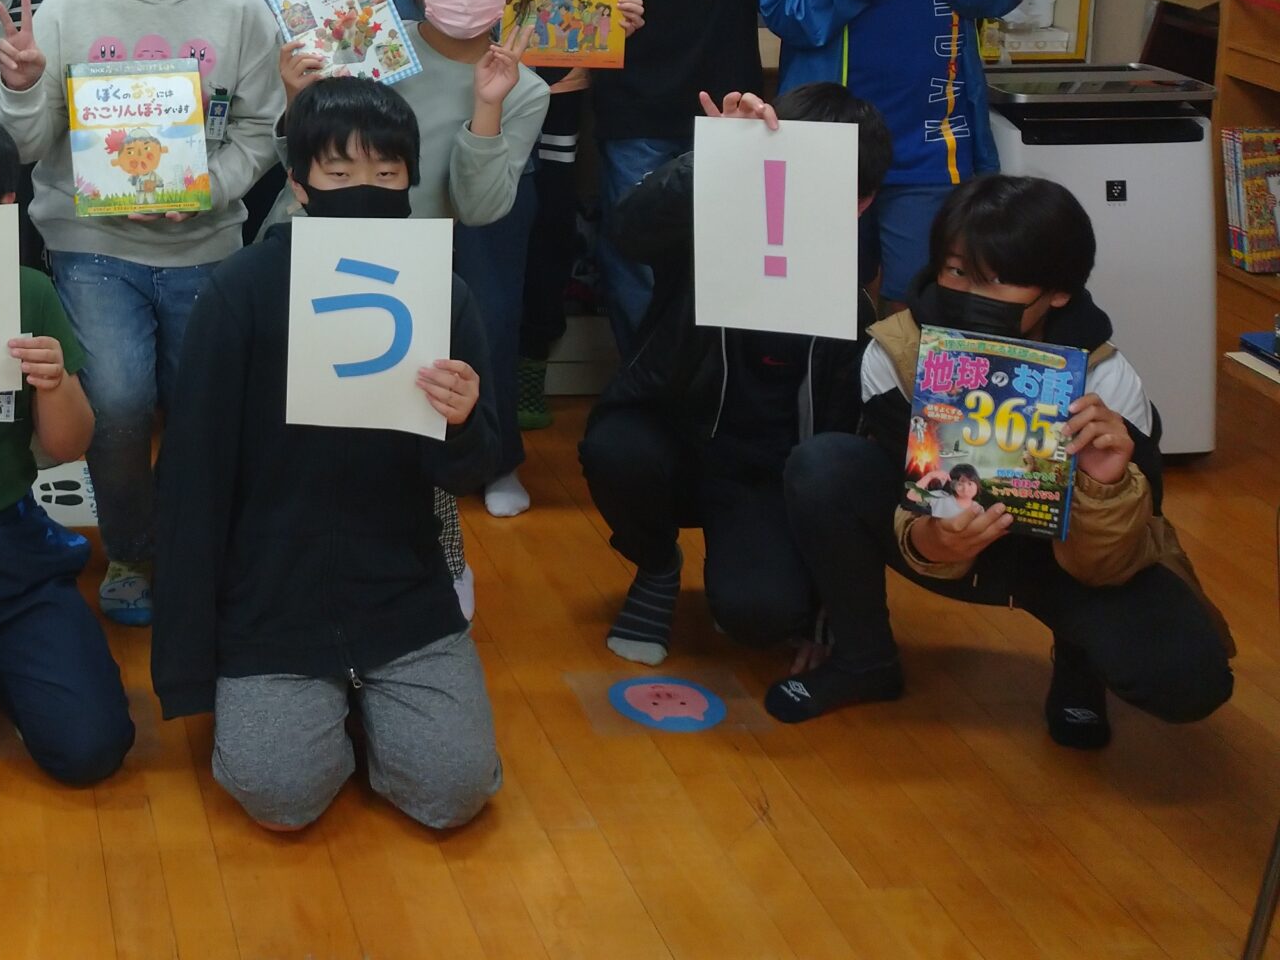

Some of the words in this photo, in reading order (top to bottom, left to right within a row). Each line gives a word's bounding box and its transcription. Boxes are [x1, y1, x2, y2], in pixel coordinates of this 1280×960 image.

[83, 98, 190, 121] おこりんぼうがいます
[311, 257, 413, 378] う
[921, 350, 1074, 416] 地球のお話
